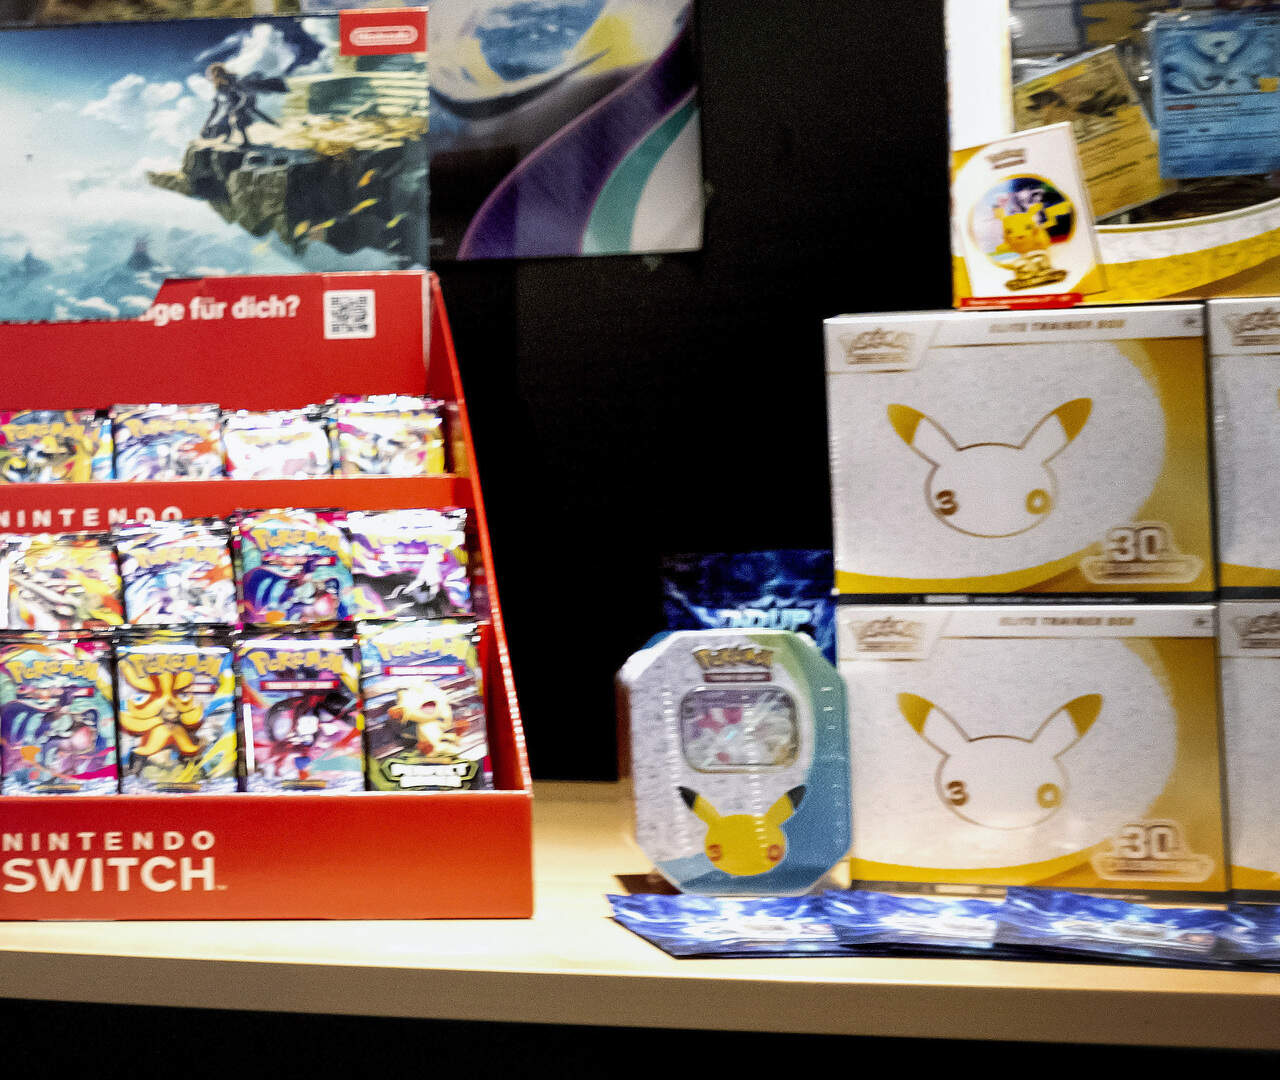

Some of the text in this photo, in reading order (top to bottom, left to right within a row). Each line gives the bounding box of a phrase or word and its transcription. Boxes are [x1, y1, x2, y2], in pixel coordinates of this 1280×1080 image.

[189, 296, 225, 320] für
[232, 294, 301, 319] dich?
[2, 830, 216, 851] NINTENDO
[2, 855, 216, 893] SWITCH
